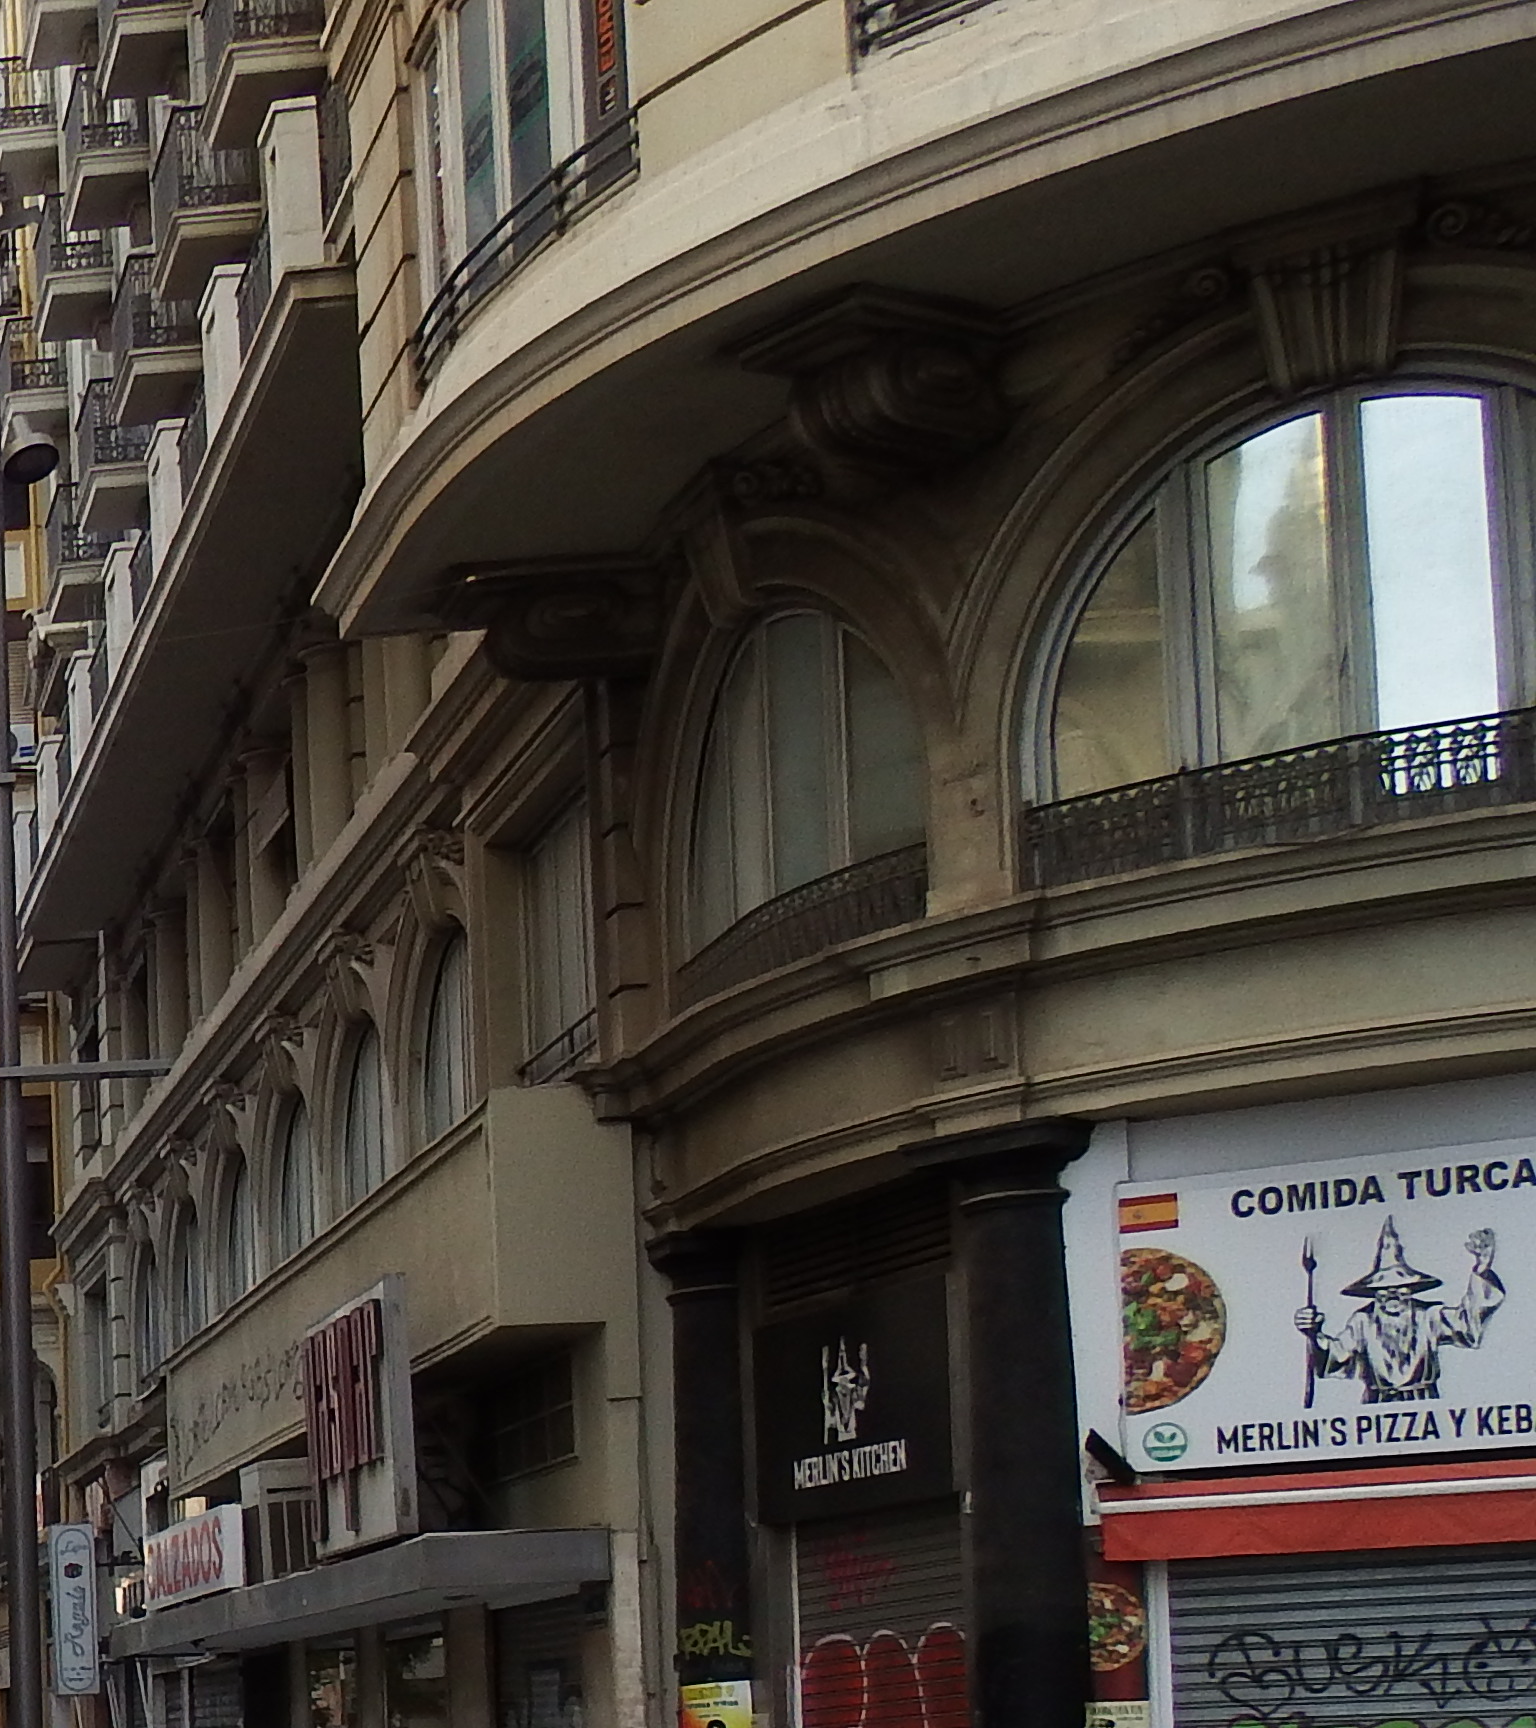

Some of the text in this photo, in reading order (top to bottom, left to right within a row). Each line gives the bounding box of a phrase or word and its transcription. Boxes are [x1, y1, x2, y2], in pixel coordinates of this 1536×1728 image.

[1230, 1157, 1536, 1218] COMIDA TURCA
[1216, 1403, 1536, 1455] MERLIN'S PIZZA Y KEB
[793, 1439, 908, 1491] MERLIN'S KITCHEN
[145, 1515, 224, 1601] CALZADOS
